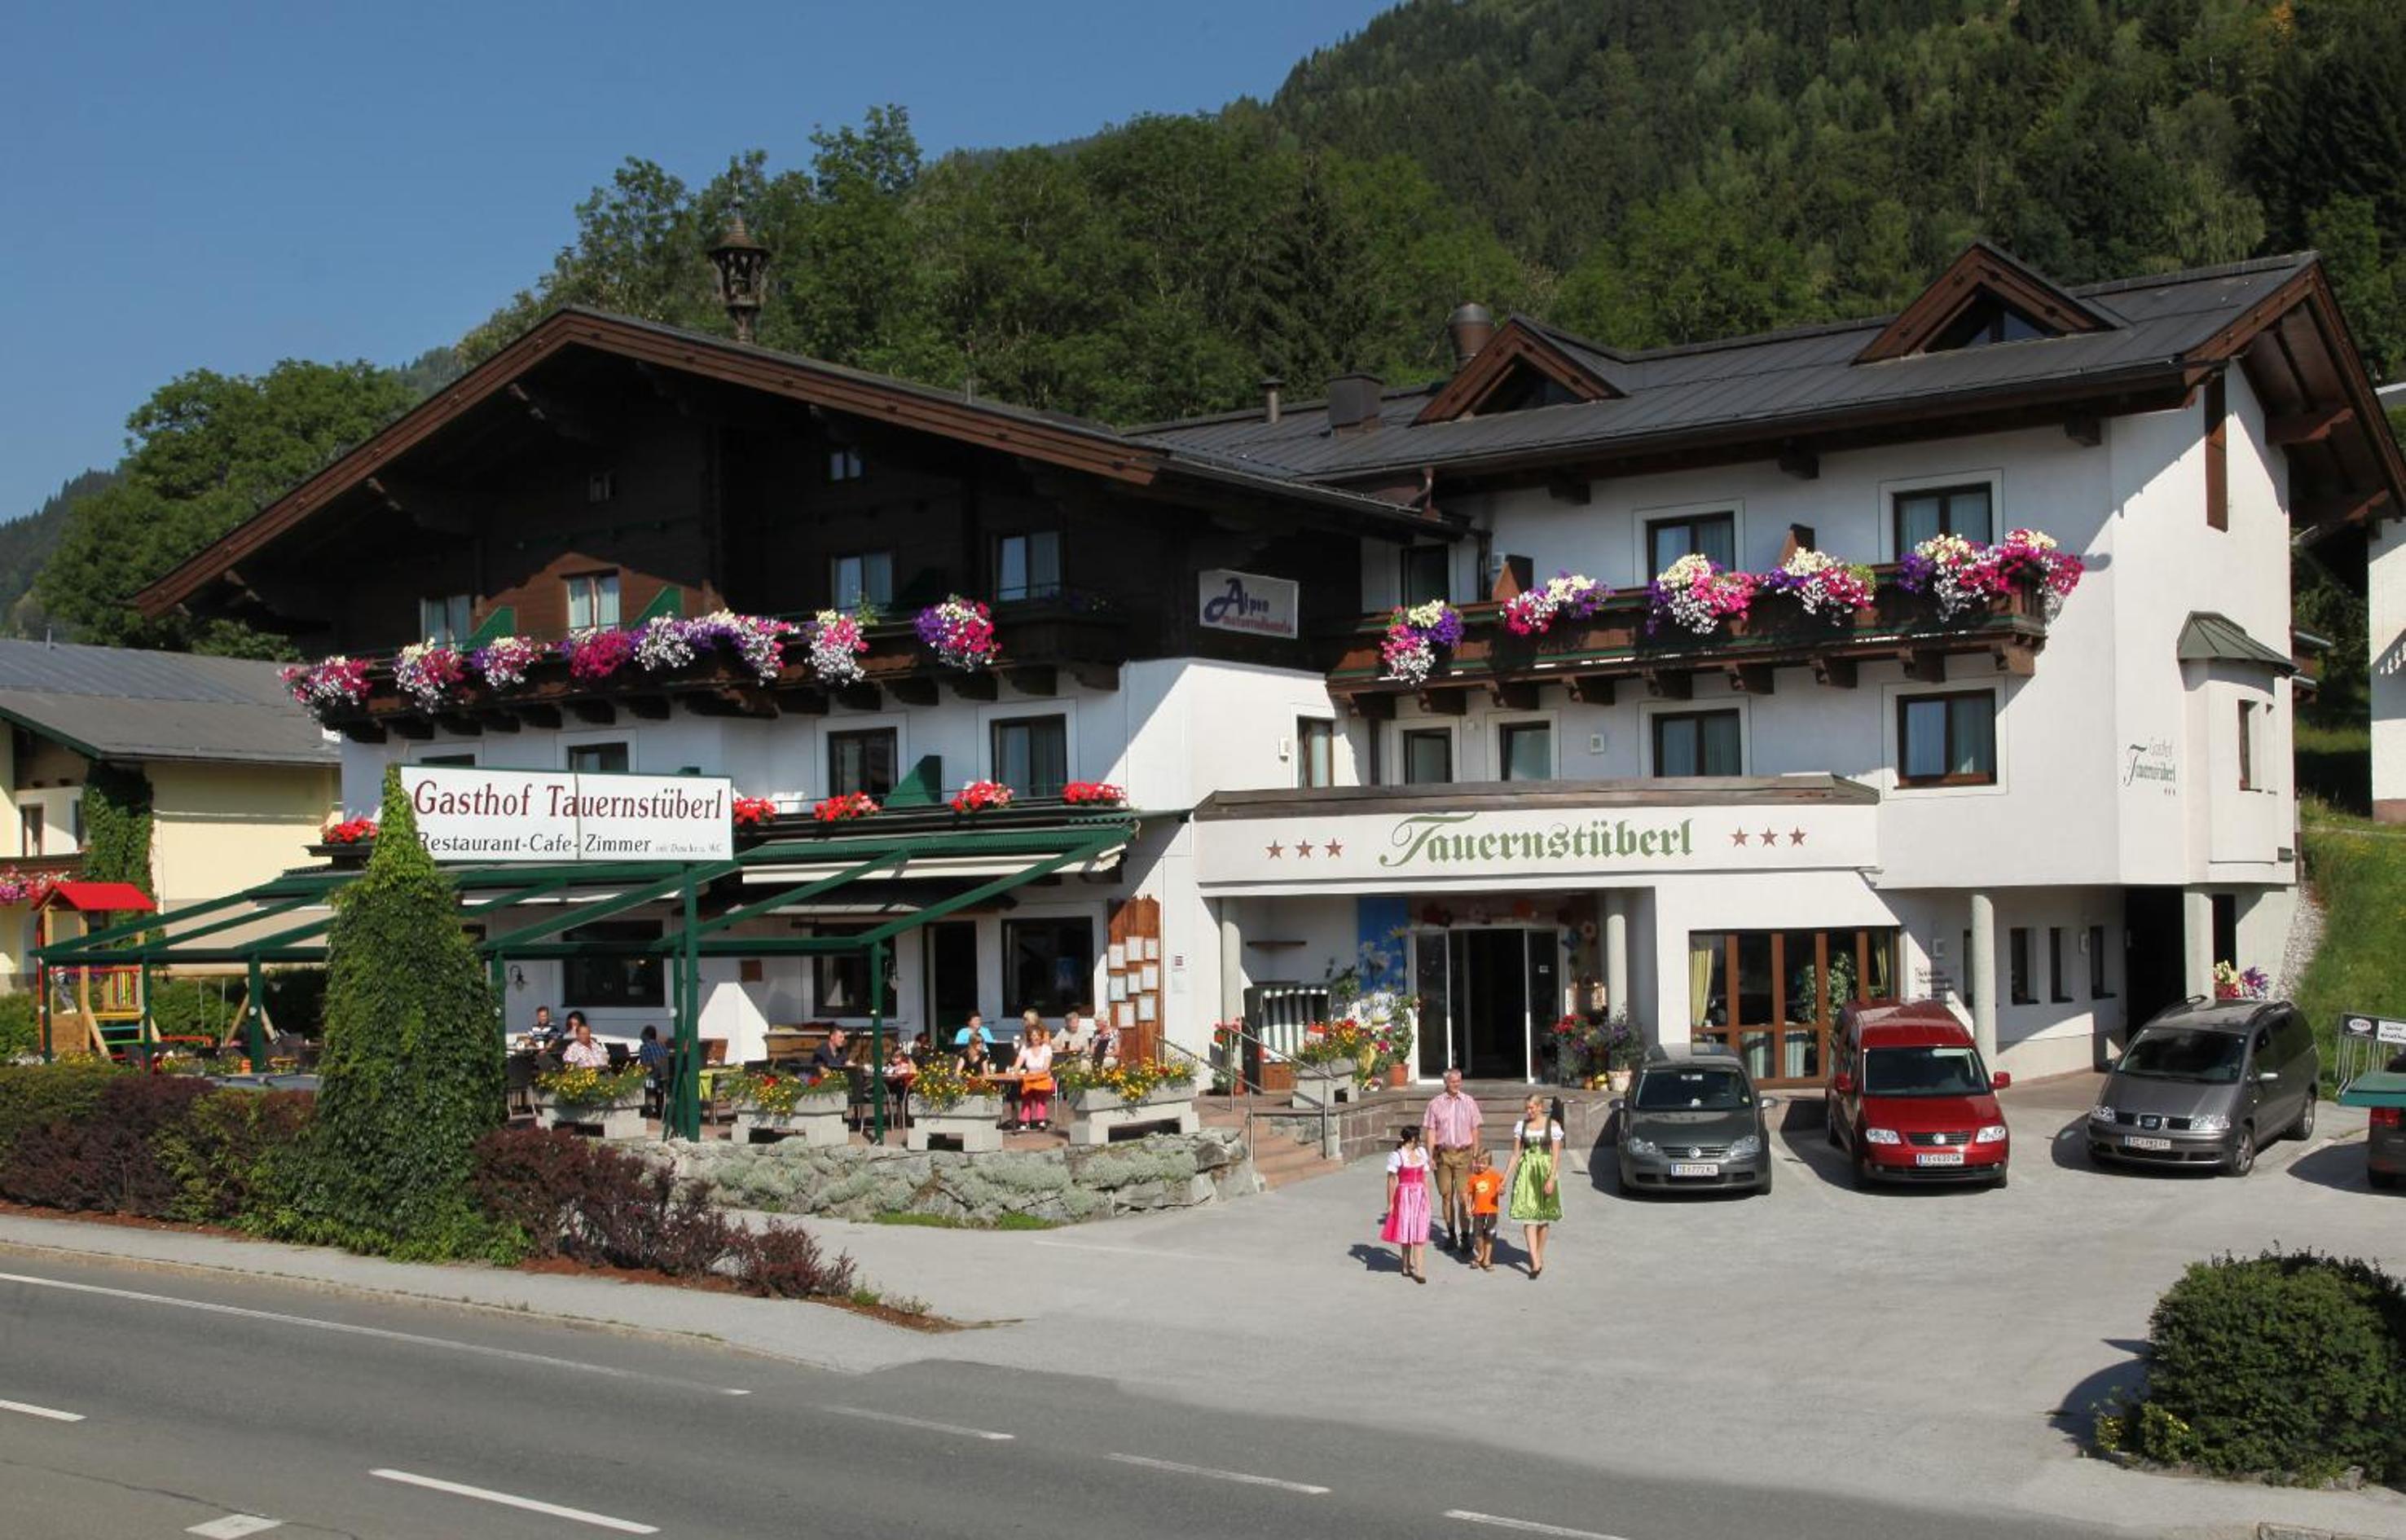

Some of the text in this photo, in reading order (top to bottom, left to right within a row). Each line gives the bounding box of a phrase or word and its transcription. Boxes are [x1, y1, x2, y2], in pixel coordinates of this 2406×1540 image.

[414, 780, 724, 820] Gasthof Tauernstüberl
[585, 834, 652, 853] Zimmer
[1379, 810, 1694, 867] Tauernstüberl
